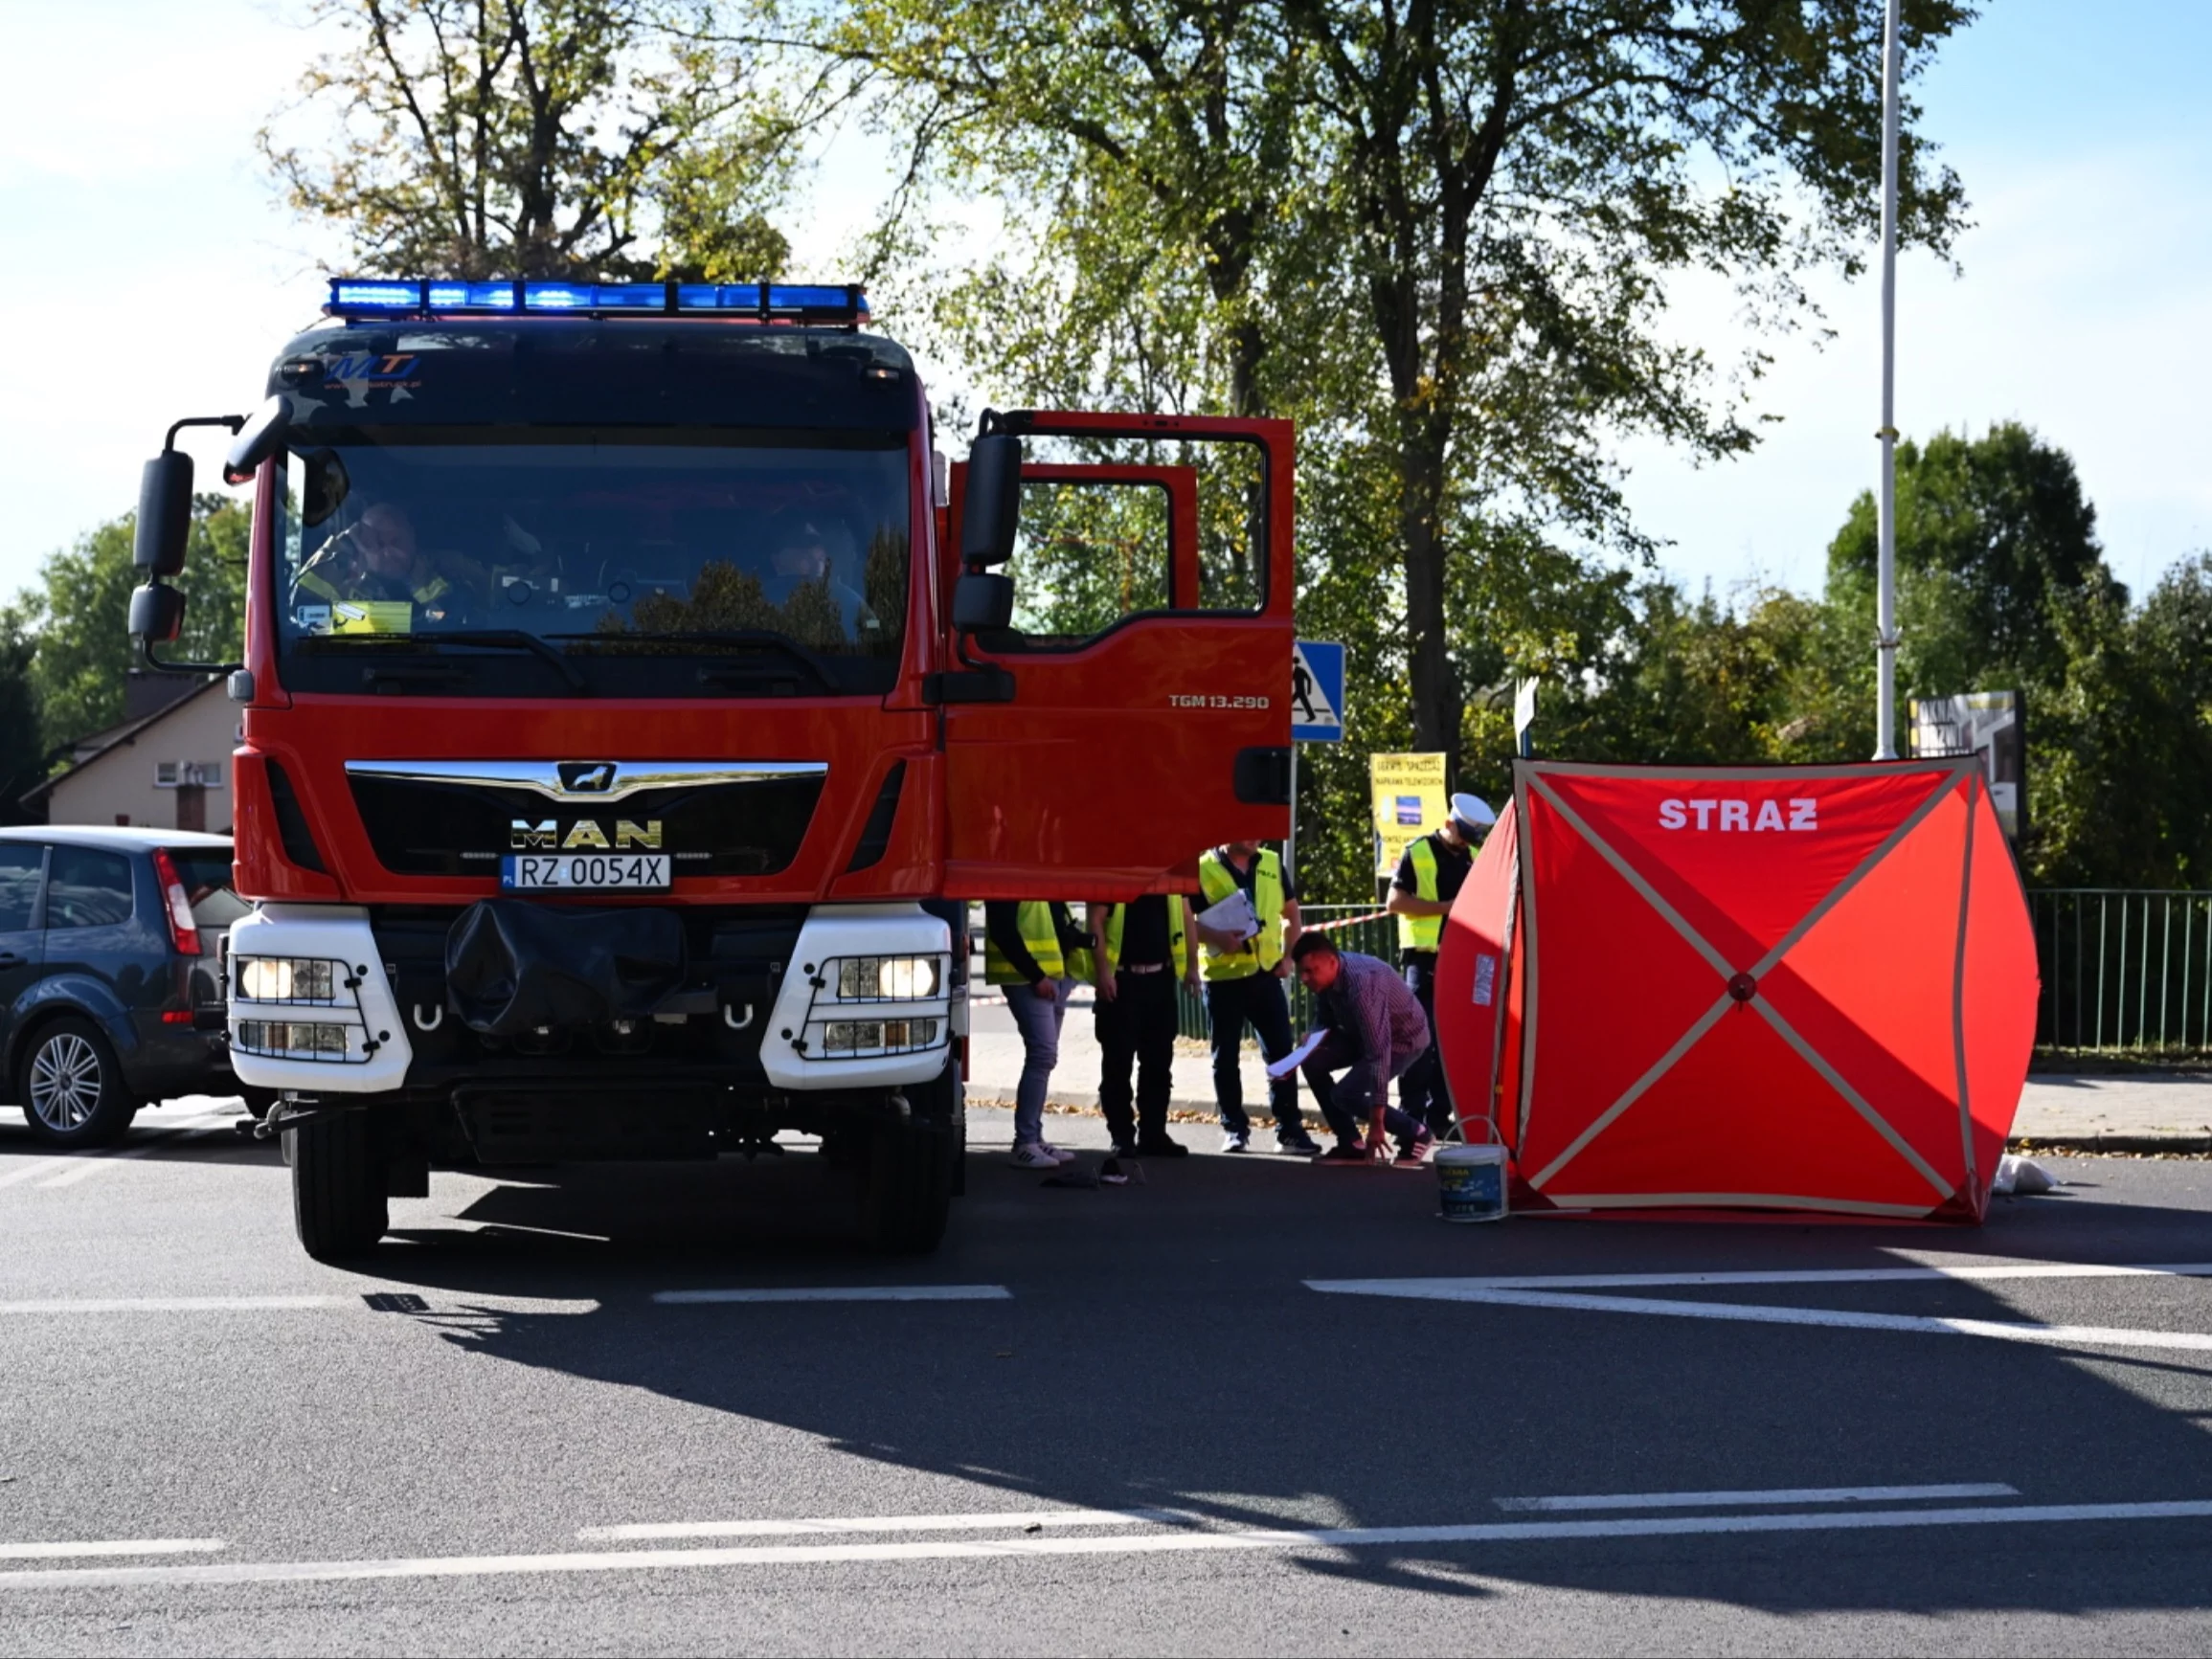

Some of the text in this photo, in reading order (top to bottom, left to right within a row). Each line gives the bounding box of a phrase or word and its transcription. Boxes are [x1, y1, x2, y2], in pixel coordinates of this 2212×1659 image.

[1168, 695, 1270, 709] TGM 13.290
[510, 819, 663, 849] MAN
[521, 858, 663, 886] RZ 0054X
